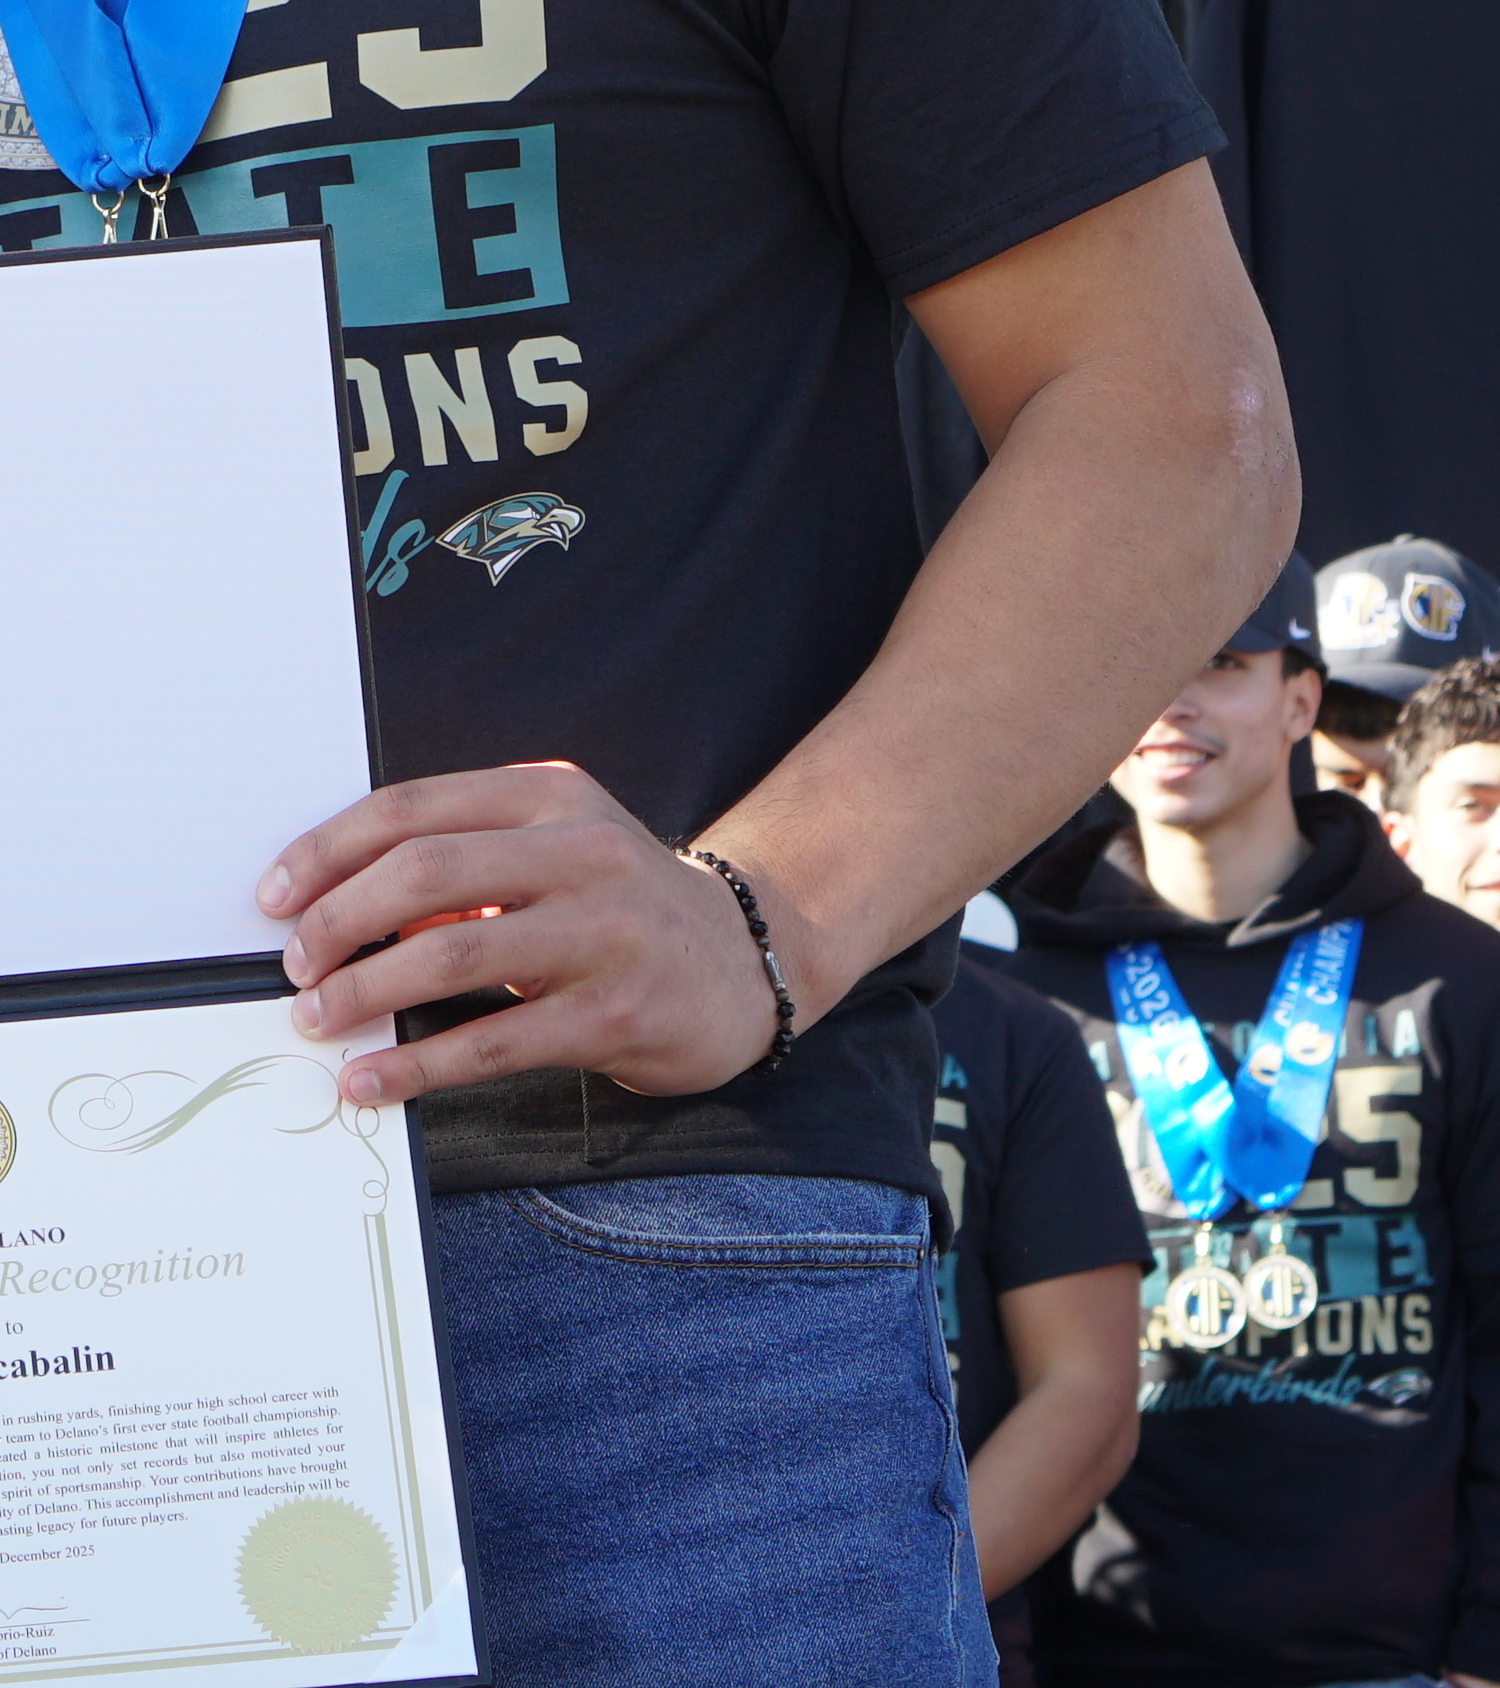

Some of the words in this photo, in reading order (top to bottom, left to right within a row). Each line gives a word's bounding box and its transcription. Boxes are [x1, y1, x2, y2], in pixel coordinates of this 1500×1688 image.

[4, 1322, 25, 1335] to
[1, 1414, 14, 1426] in
[16, 1411, 64, 1424] rushing
[65, 1407, 104, 1423] yards,
[107, 1402, 163, 1417] finishing
[164, 1402, 194, 1415] your
[195, 1396, 225, 1411] high
[226, 1392, 268, 1406] school
[270, 1392, 309, 1403] career
[311, 1386, 340, 1398] with
[33, 1451, 42, 1460] a
[46, 1444, 93, 1458] historic
[99, 1441, 159, 1454] milestone
[164, 1436, 188, 1448] that
[193, 1433, 219, 1445] will
[224, 1429, 267, 1445] inspire
[272, 1426, 320, 1439] athletes
[325, 1423, 344, 1434] for
[30, 1468, 56, 1481] you
[60, 1465, 81, 1476] not
[86, 1461, 114, 1475] only
[119, 1460, 138, 1471] set
[142, 1454, 189, 1468] records
[193, 1453, 214, 1464] but
[219, 1450, 246, 1462] also
[250, 1443, 312, 1459] motivated
[316, 1443, 346, 1457] your
[0, 1486, 33, 1502] spirit
[36, 1485, 50, 1496] of
[53, 1477, 146, 1497] sportsmanship.
[148, 1474, 179, 1486] Your
[182, 1467, 264, 1484] contributions
[266, 1465, 297, 1476] have
[299, 1458, 348, 1474] brought
[35, 1521, 76, 1535] legacy
[79, 1517, 98, 1529] for
[101, 1515, 138, 1527] future
[140, 1512, 189, 1527] players.
[65, 1544, 96, 1558] 2025
[12, 1645, 58, 1660] Delano
